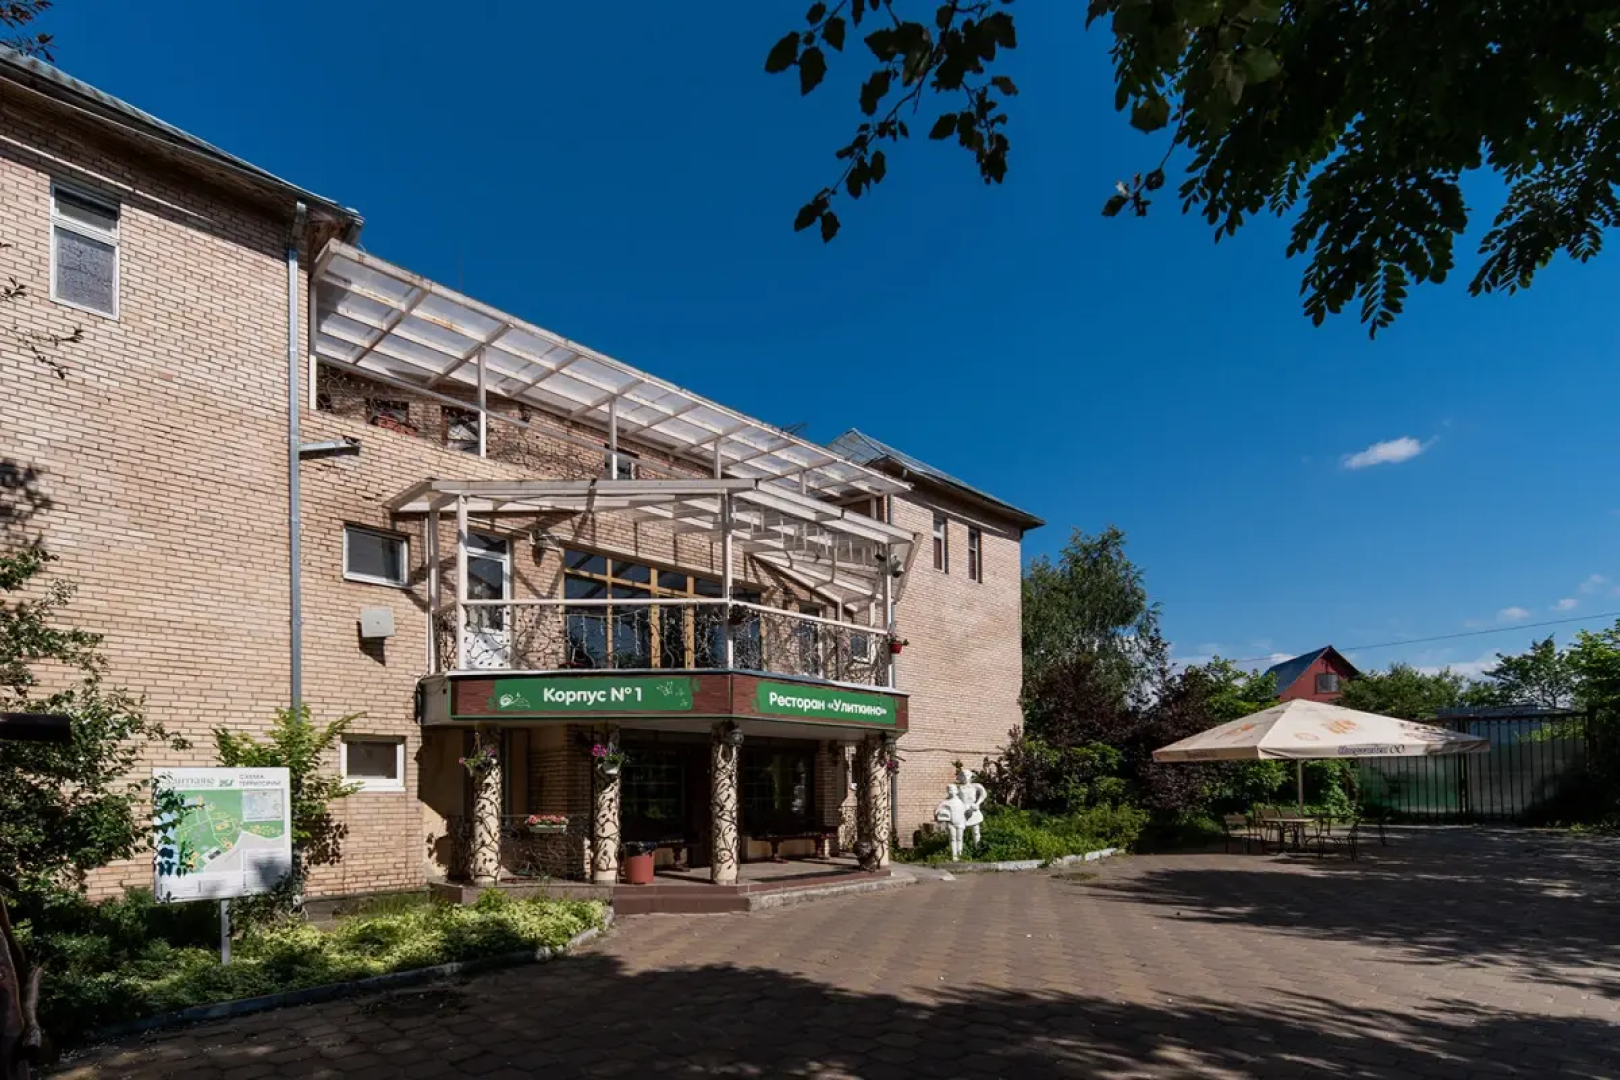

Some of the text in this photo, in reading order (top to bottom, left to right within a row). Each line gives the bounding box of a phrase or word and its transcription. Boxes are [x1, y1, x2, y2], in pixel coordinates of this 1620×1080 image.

[543, 687, 607, 706] Корпус
[768, 691, 888, 717] Ресторан «Улиткино»
